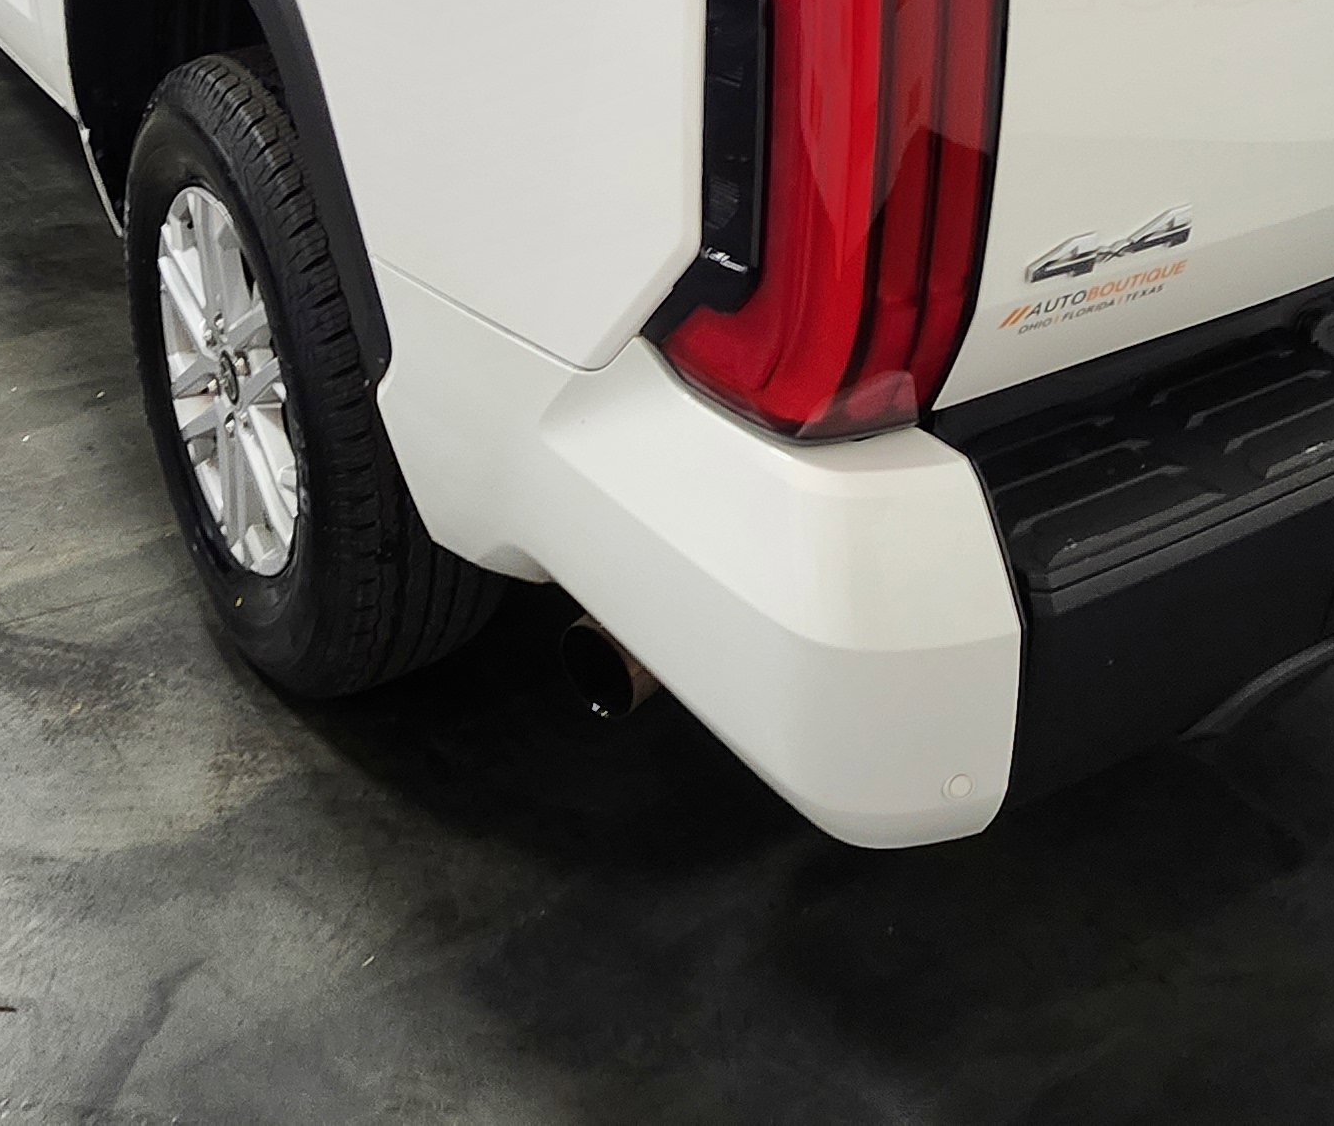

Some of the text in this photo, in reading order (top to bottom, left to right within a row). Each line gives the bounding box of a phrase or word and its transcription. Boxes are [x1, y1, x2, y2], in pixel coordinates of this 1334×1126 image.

[1018, 283, 1164, 335] OHIO FLORIDA TEXAS
[1024, 259, 1189, 320] AUTOBOUTIQUE
